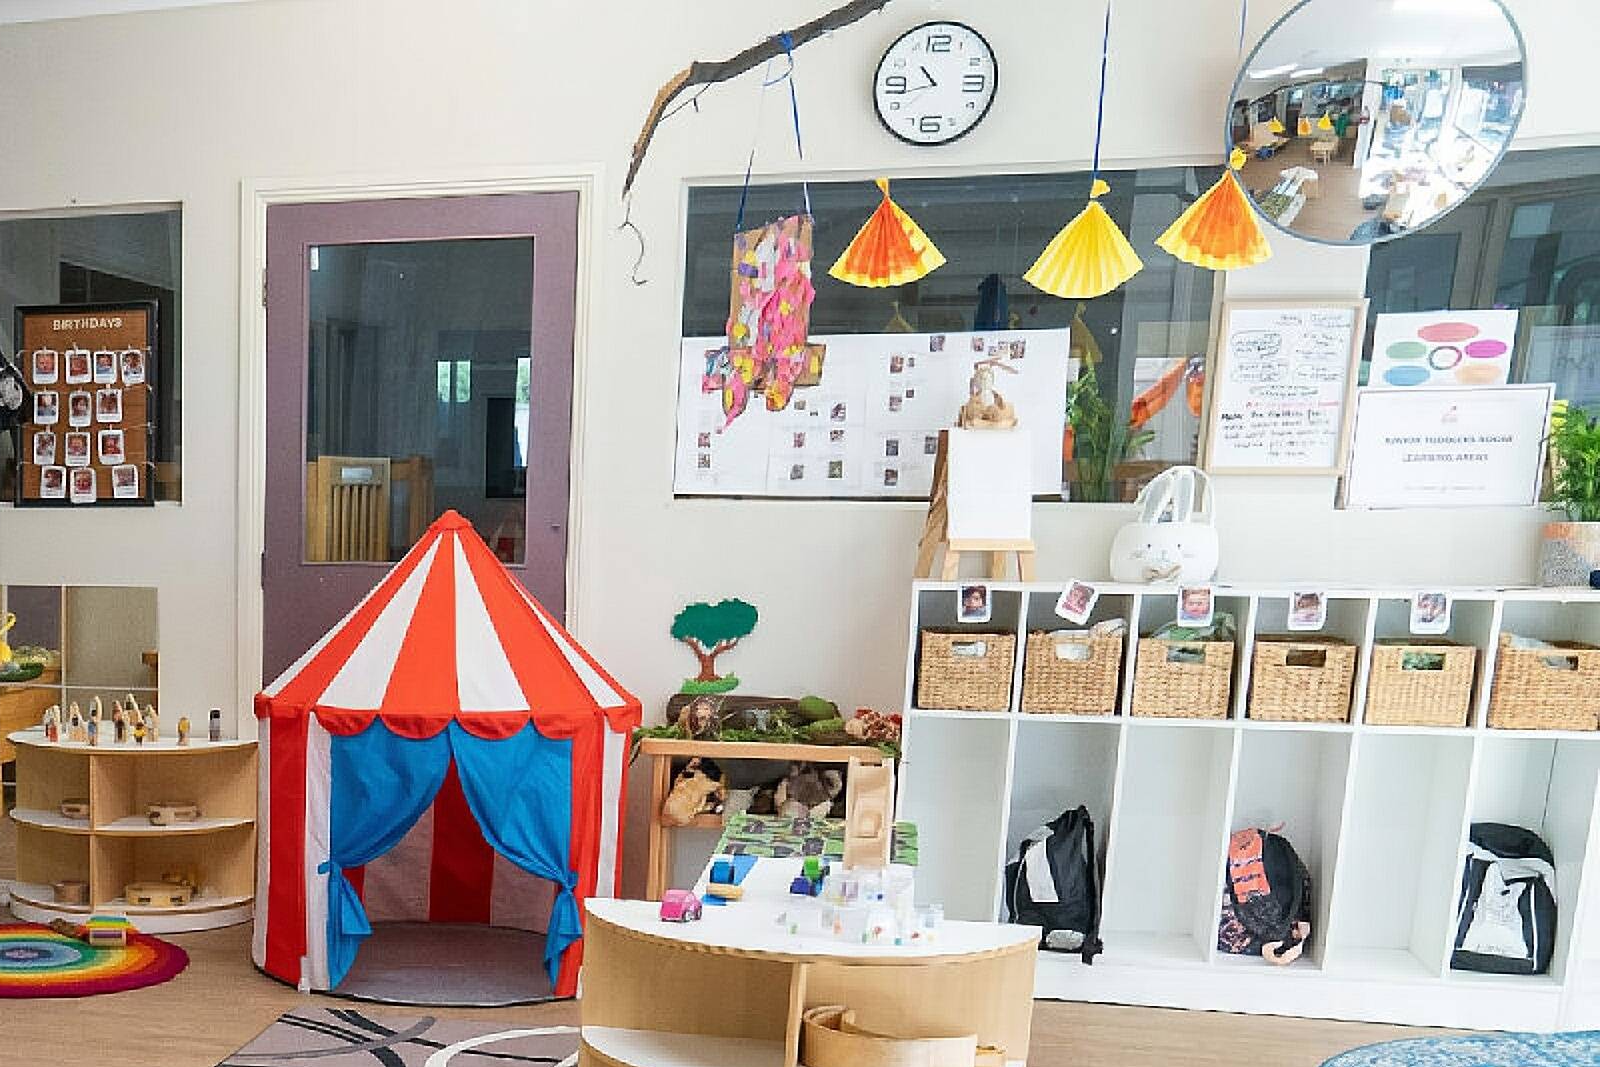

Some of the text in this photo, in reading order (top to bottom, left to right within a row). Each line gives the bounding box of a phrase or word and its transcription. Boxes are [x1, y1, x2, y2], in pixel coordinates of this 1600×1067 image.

[926, 34, 952, 53] 12
[885, 75, 907, 94] 9
[962, 74, 985, 93] 3
[919, 115, 942, 133] 6
[52, 317, 123, 331] BIRTHDAYS
